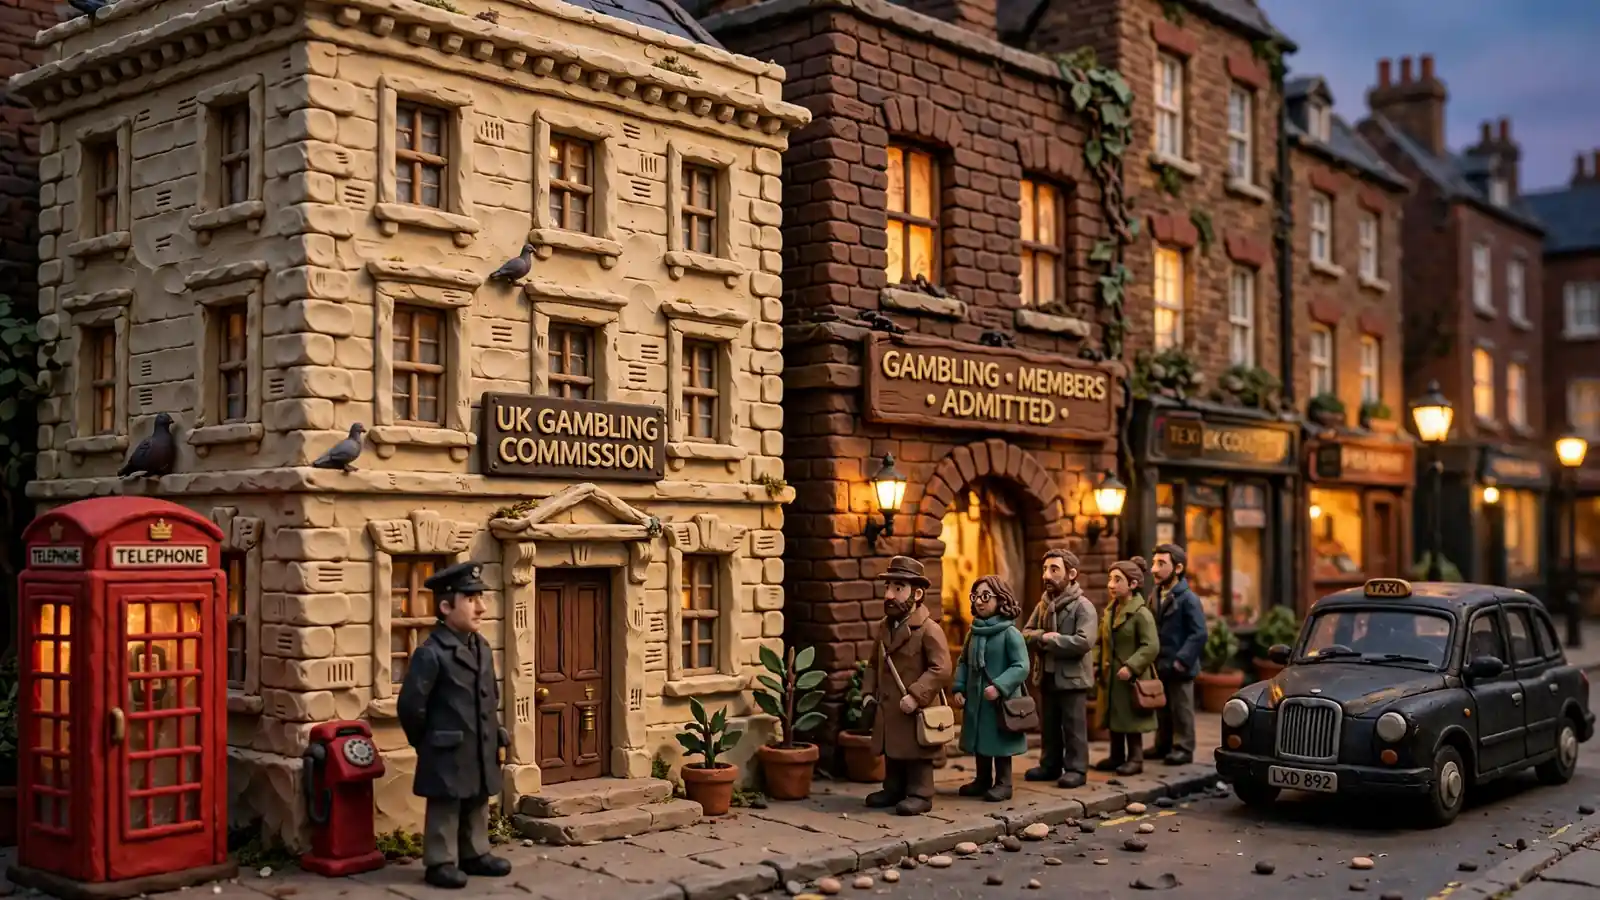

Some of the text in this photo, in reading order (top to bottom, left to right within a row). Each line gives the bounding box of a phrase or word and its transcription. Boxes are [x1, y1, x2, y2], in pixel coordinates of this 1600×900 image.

[882, 350, 1106, 400] GAMBLING MEMBERS
[941, 388, 1056, 424] ADMITTED
[496, 405, 658, 441] UK GAMBLING
[499, 437, 654, 469] COMMISSION
[116, 549, 204, 563] TELEPHONE
[1370, 583, 1400, 594] TAXI
[1273, 769, 1332, 789] LXD 892
